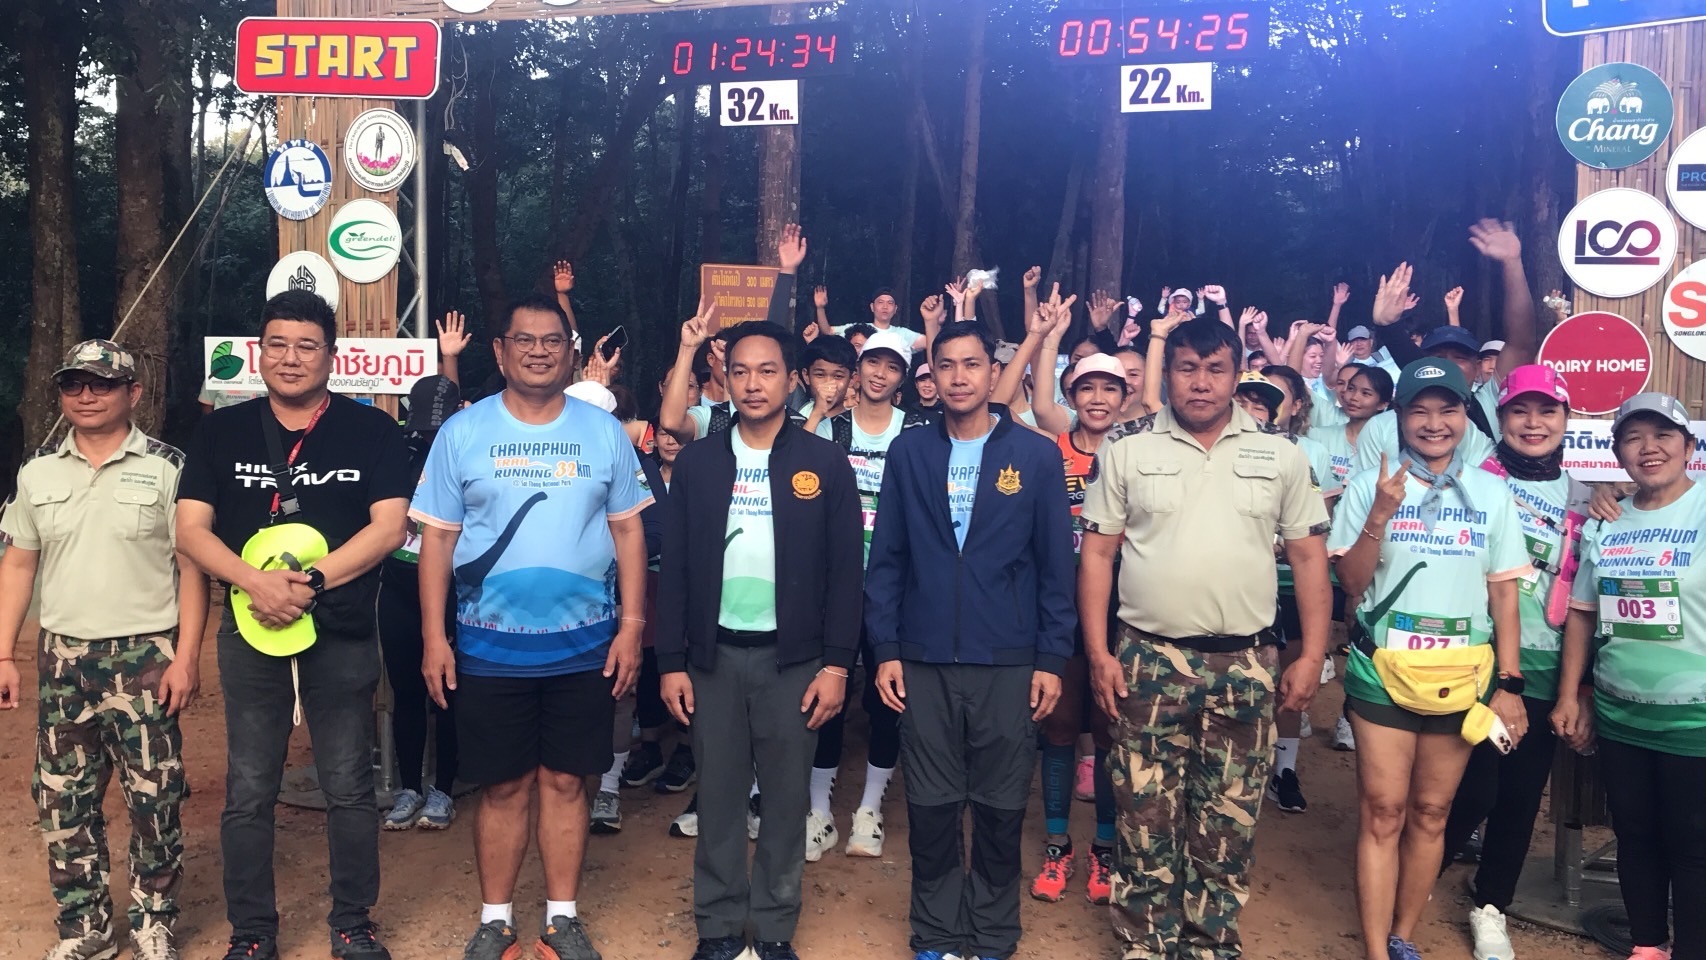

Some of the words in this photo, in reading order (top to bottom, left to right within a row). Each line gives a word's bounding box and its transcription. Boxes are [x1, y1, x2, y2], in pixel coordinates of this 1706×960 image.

[1058, 12, 1250, 57] 00:54:25
[255, 34, 420, 80] START
[672, 33, 837, 76] 01:24:34
[1128, 67, 1172, 106] 22
[1176, 83, 1205, 104] Km.
[726, 86, 766, 123] 32
[769, 102, 794, 122] Km.
[1568, 117, 1659, 145] Chang
[1543, 359, 1592, 373] DAIRY
[1596, 359, 1646, 372] HOME
[490, 442, 581, 458] CHAIYAPHUM
[235, 461, 308, 476] HILX
[494, 468, 552, 479] RUNNING
[1390, 532, 1455, 546] RUNNING
[1600, 528, 1698, 546] CHAIYAPHUM
[1597, 556, 1656, 568] RUNNING
[1617, 599, 1657, 619] 003
